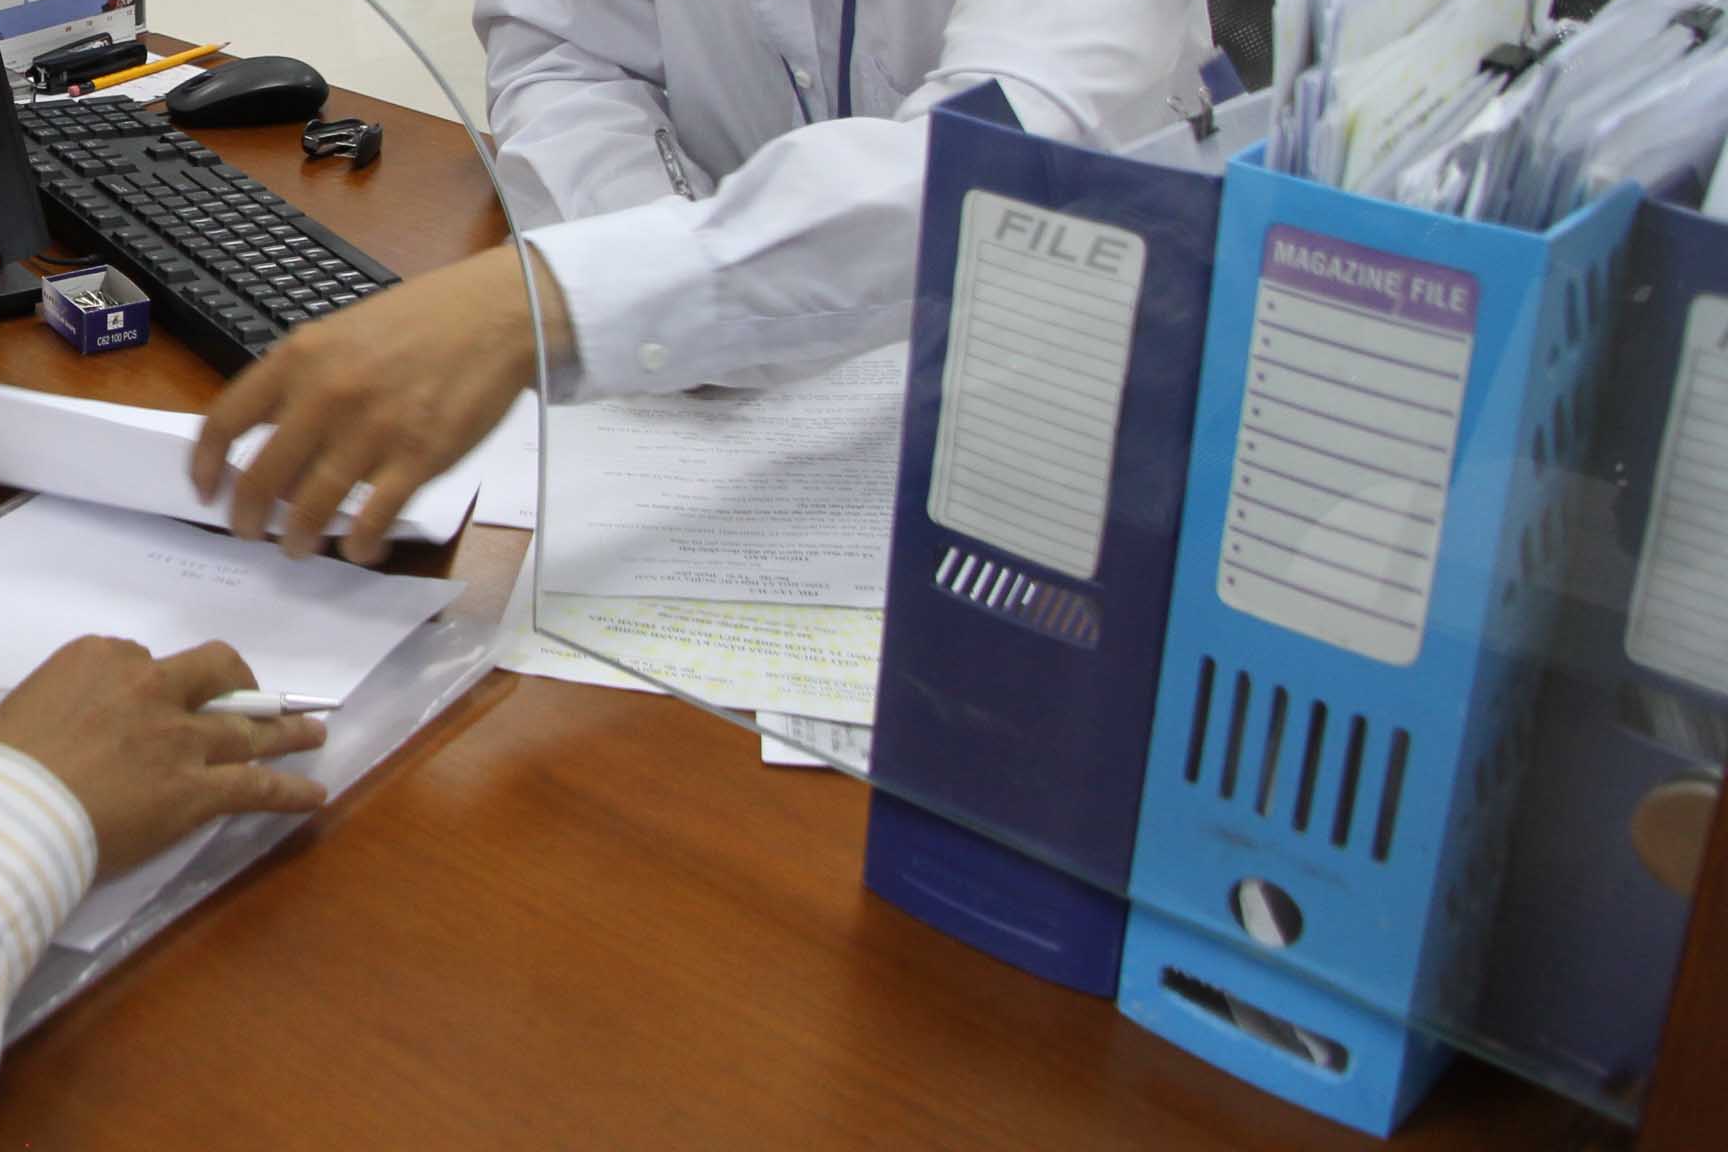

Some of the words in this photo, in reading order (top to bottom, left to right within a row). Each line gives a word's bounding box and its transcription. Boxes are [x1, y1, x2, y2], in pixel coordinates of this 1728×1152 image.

[993, 208, 1130, 277] FILE
[1273, 239, 1404, 298] MAGAZINE
[1409, 277, 1470, 314] FILE
[123, 329, 137, 342] PCS
